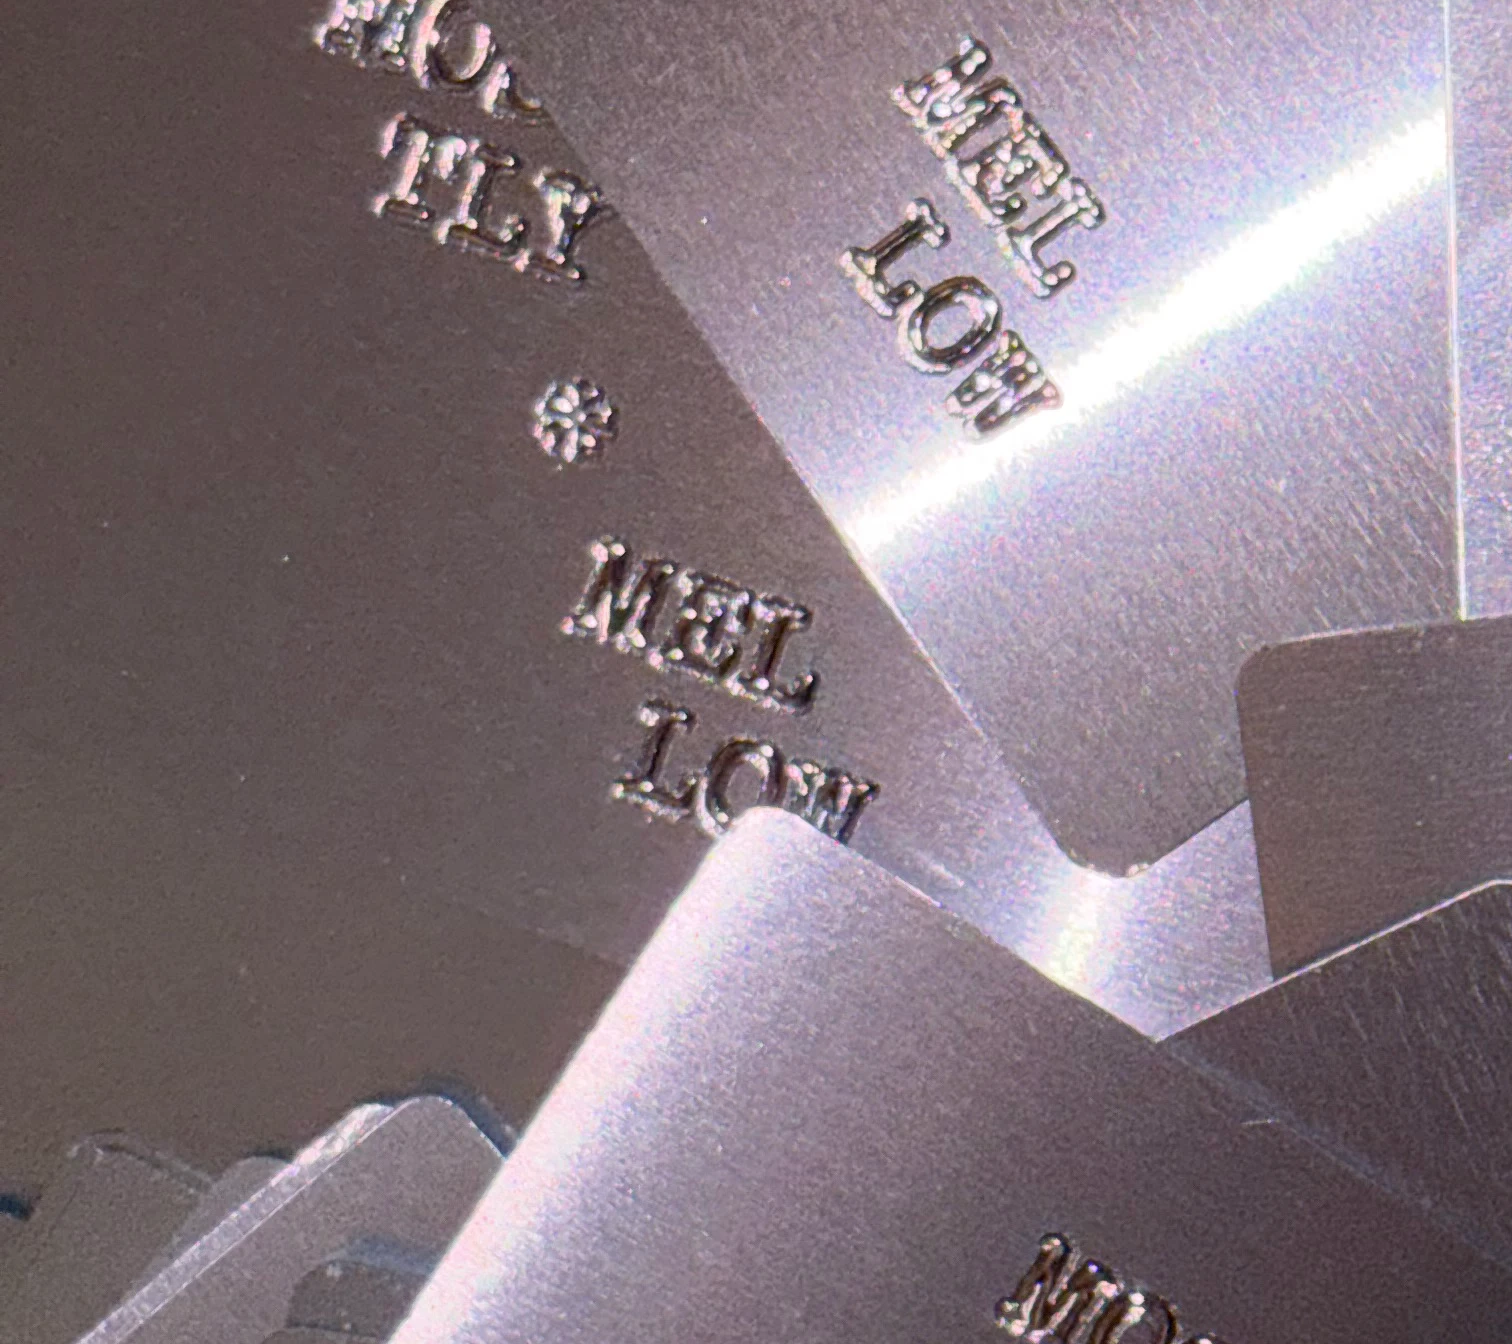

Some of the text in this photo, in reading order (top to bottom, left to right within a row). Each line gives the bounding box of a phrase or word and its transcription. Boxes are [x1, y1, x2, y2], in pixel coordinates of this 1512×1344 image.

[370, 111, 612, 286] TLY
[890, 34, 1106, 299] MEL
[840, 197, 1062, 442] LOW
[559, 536, 822, 718] MEL
